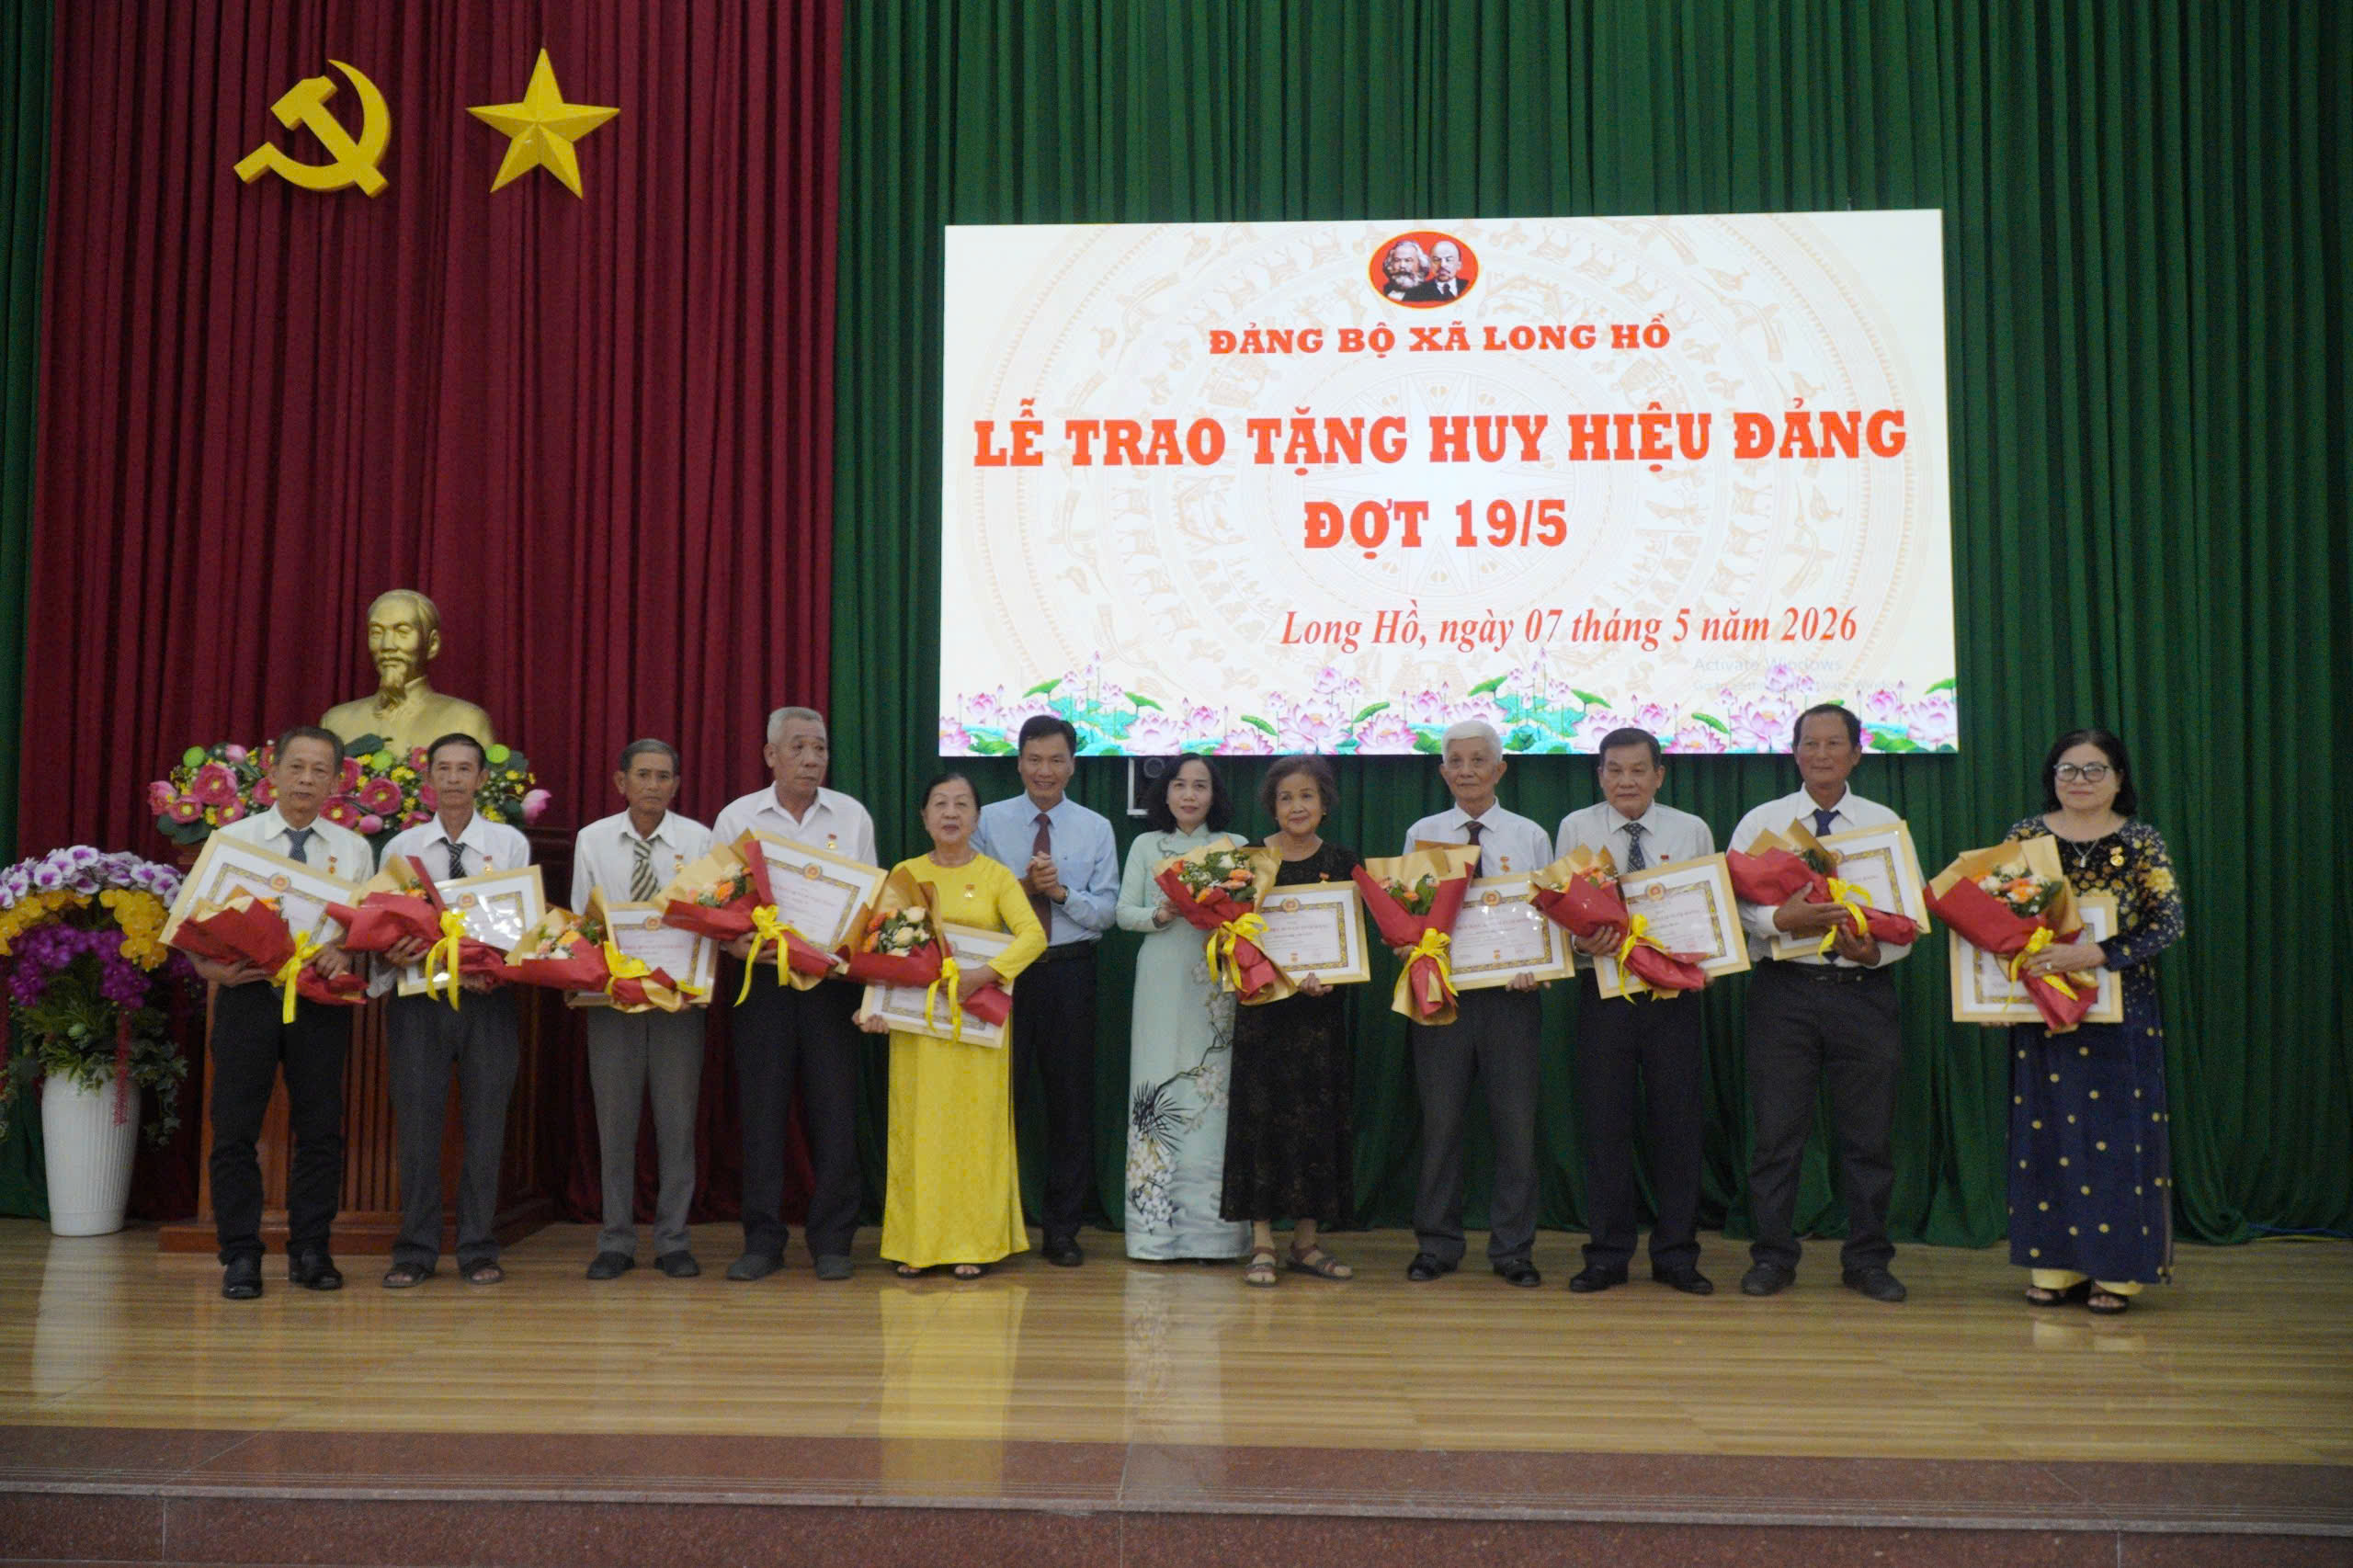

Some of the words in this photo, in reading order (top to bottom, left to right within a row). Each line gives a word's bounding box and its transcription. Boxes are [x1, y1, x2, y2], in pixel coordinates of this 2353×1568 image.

[1209, 322, 1324, 354] ĐẢNG
[1337, 322, 1395, 358] BỘ
[1409, 322, 1471, 352] XÃ
[1483, 324, 1597, 351] LONG
[1610, 313, 1670, 349] HỒ
[973, 398, 1044, 467] LỄ
[1064, 417, 1226, 467] TRAO
[1246, 407, 1407, 476] TẶNG
[1429, 415, 1549, 462] HUY
[1568, 402, 1712, 473] HIỆU
[1733, 397, 1907, 460] ĐẢNG
[1304, 499, 1429, 560] ĐỢT
[1455, 499, 1567, 548] 19/5
[1280, 611, 1362, 653] Long
[1371, 599, 1427, 650] Hồ,
[1439, 609, 1514, 653] ngày
[1525, 608, 1563, 642] 07
[1571, 608, 1662, 652] tháng
[1673, 608, 1690, 642] 5
[1701, 607, 1770, 642] năm
[1781, 606, 1858, 642] 2026
